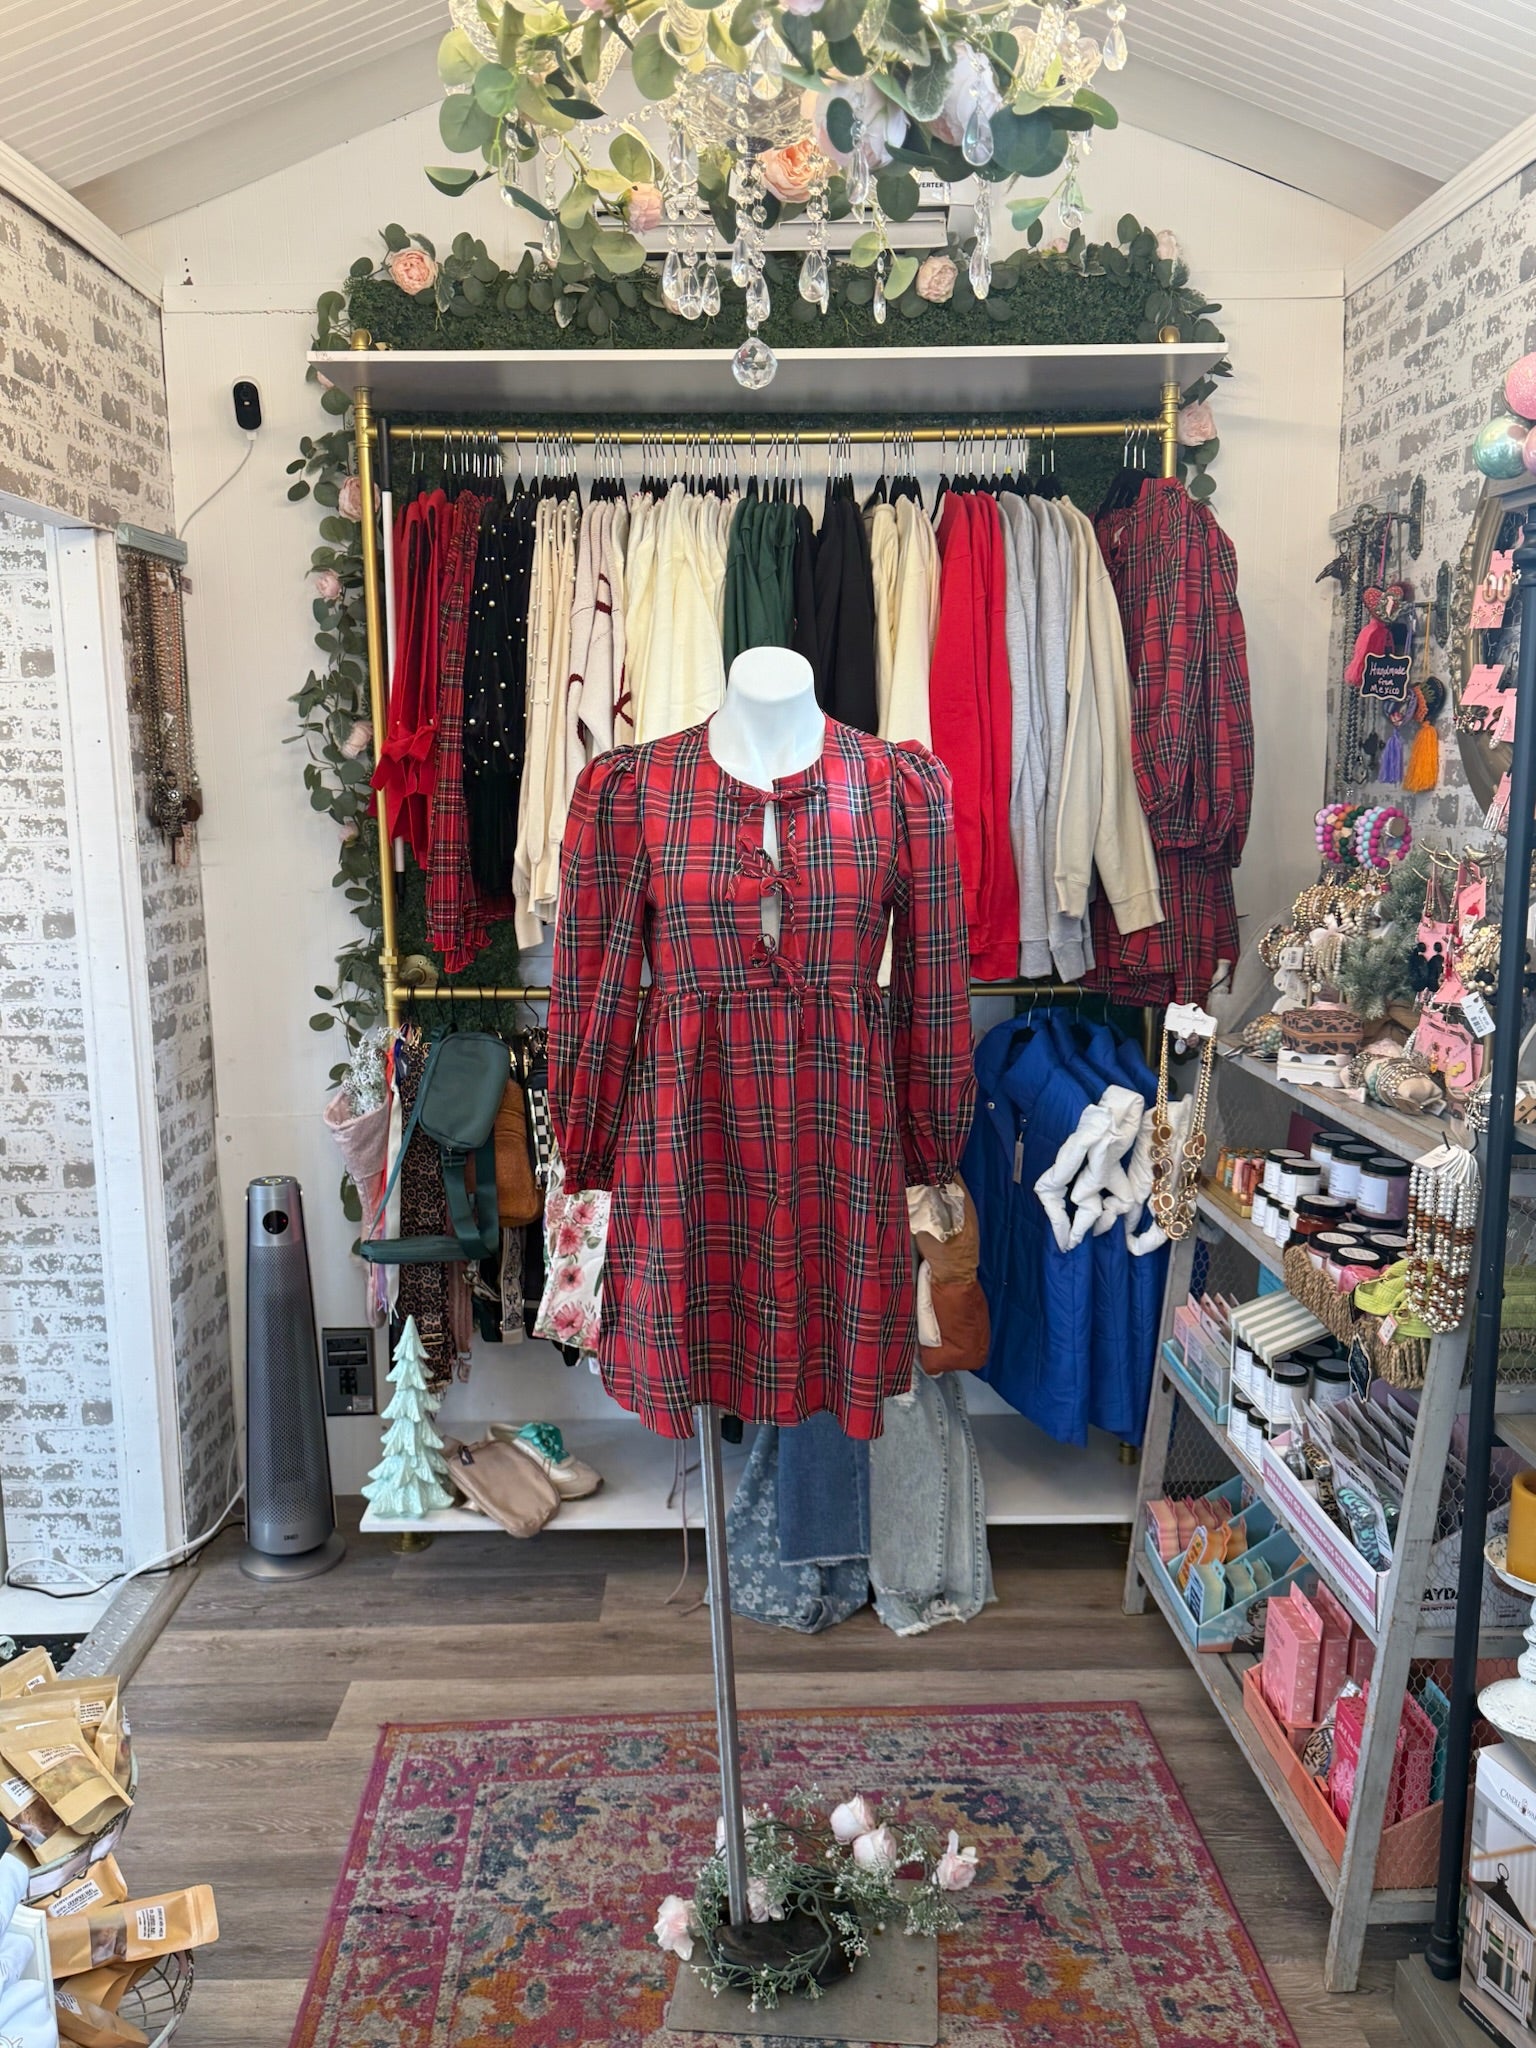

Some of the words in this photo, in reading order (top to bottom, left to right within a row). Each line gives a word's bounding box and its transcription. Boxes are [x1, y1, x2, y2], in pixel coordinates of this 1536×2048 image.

[1369, 662, 1406, 677] Handmade
[1378, 678, 1394, 686] from
[1370, 684, 1400, 694] Mexico
[1300, 1509, 1335, 1557] DANGEROUS
[1334, 1551, 1370, 1601] SITUATIONS
